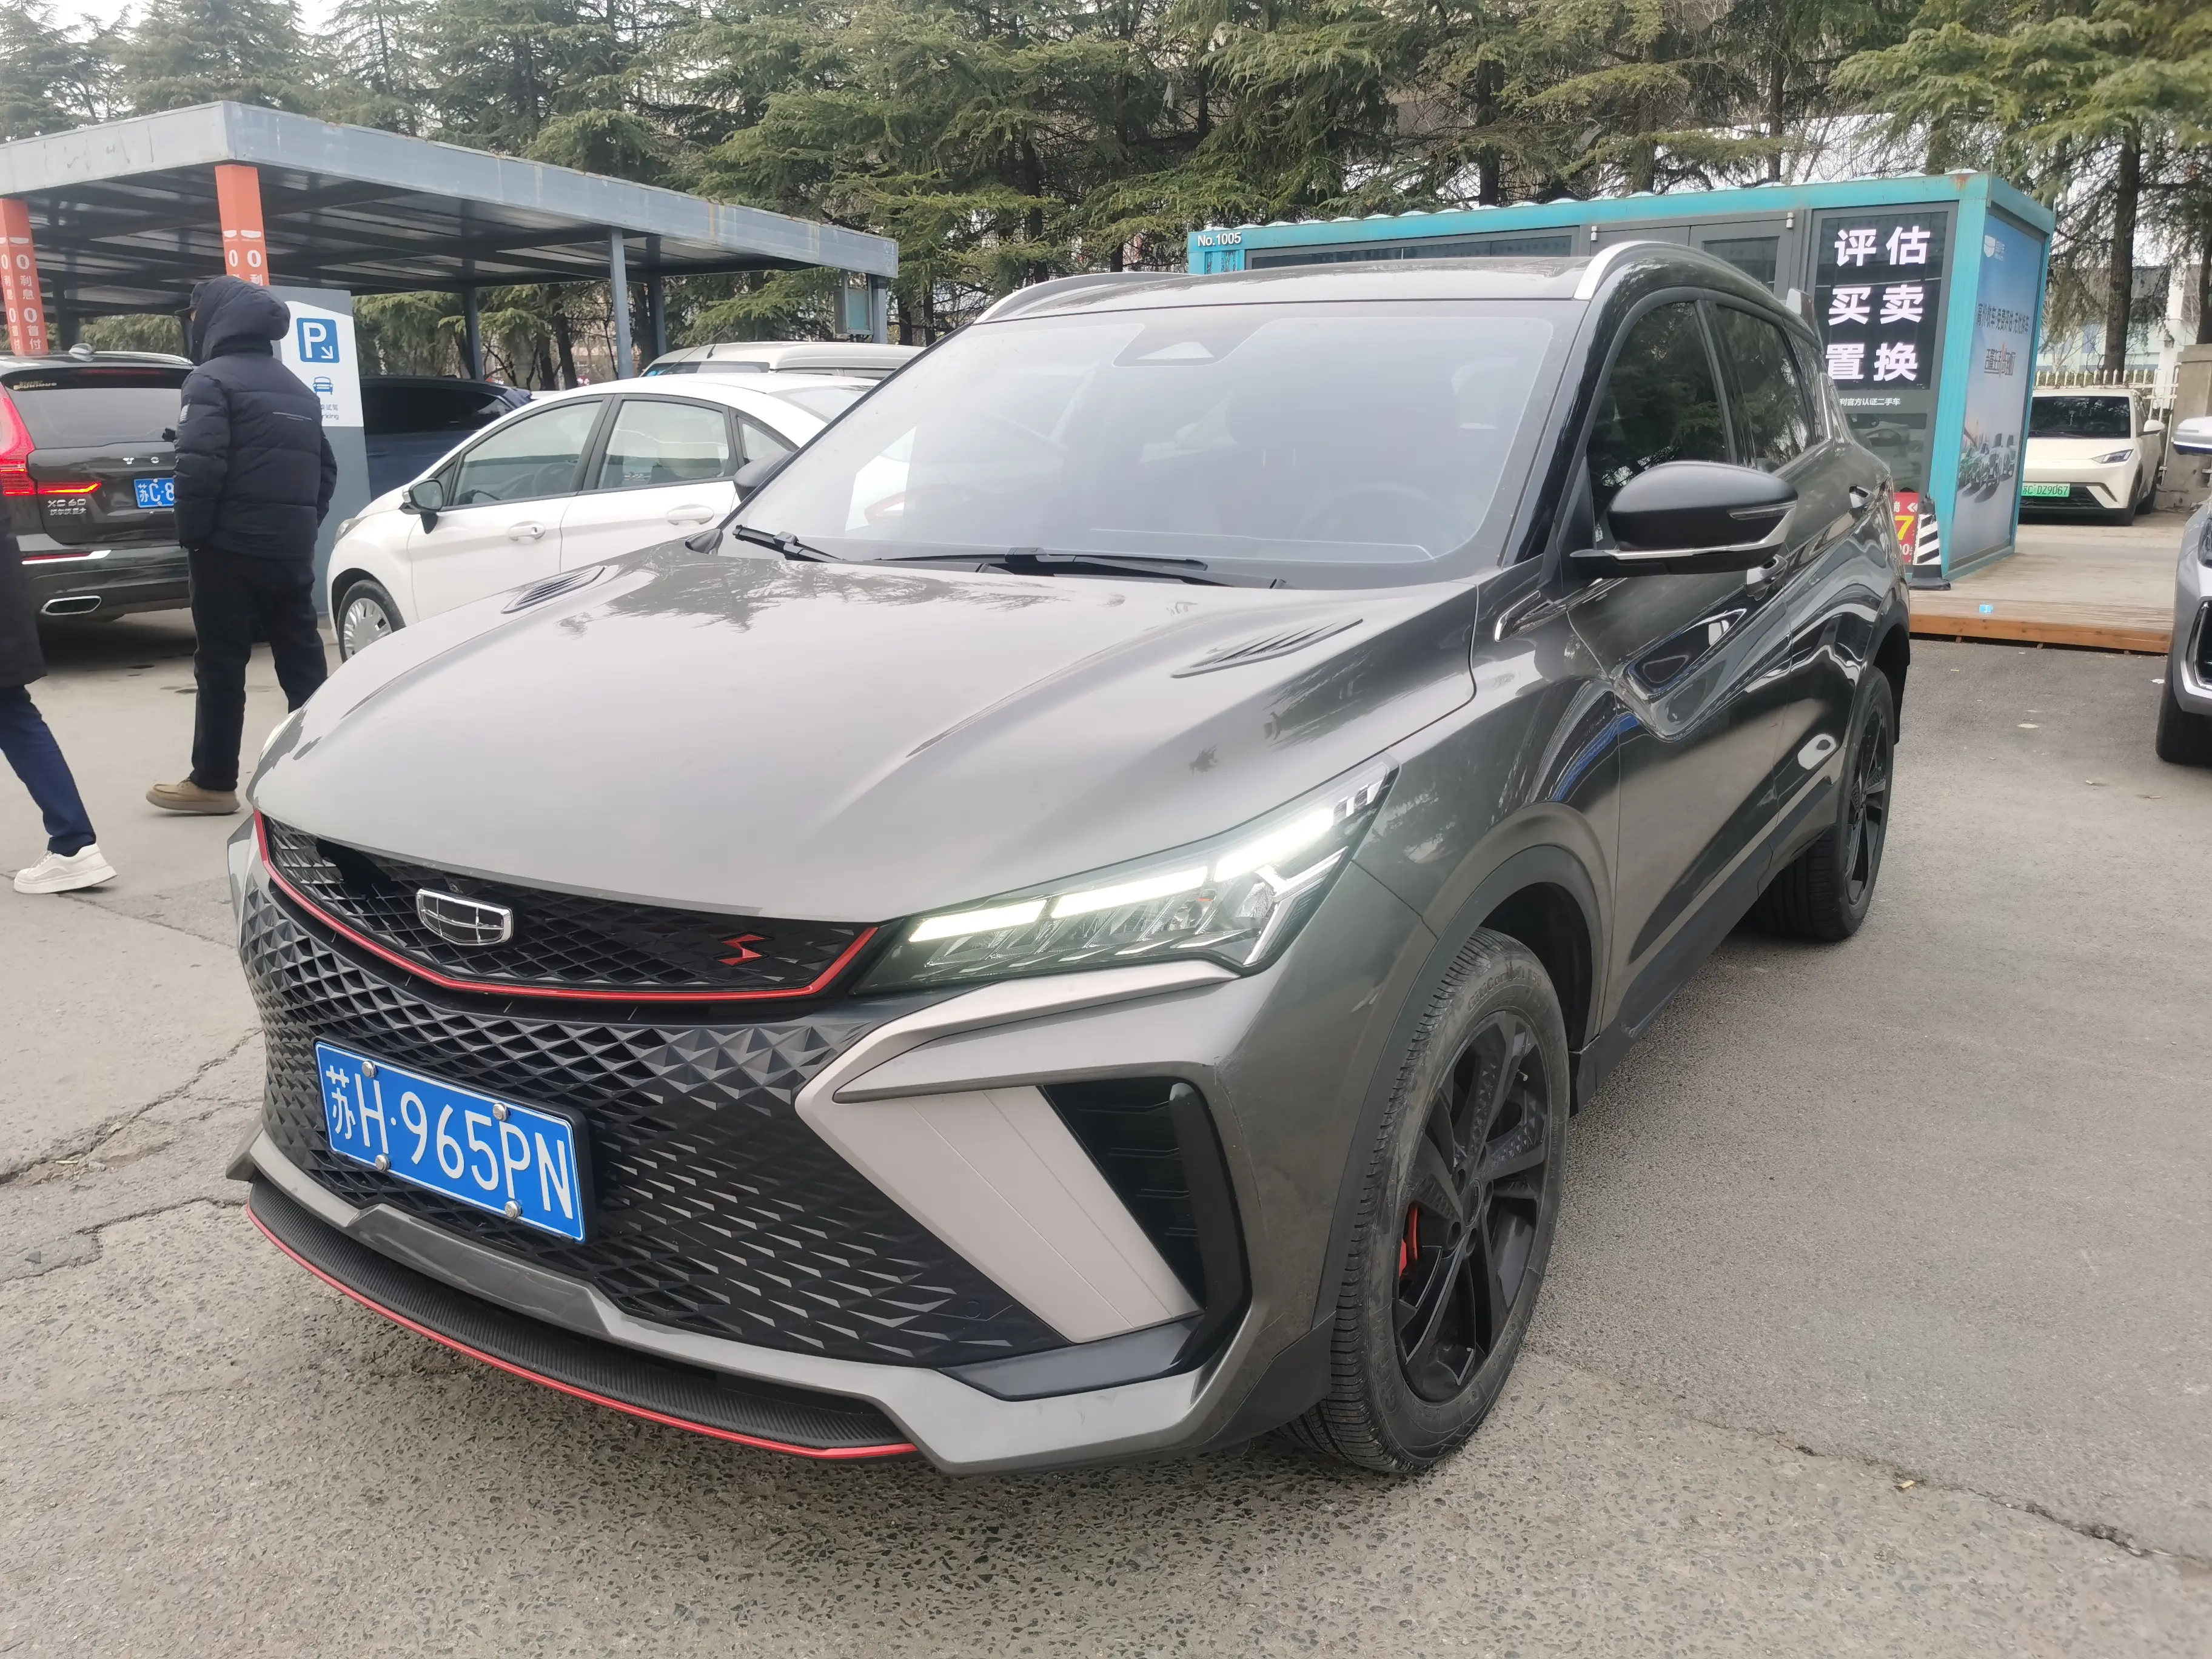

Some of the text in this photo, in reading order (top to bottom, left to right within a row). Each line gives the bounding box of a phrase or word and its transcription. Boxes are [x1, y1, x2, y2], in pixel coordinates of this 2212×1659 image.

[1198, 232, 1242, 247] No.1005
[1834, 226, 1931, 267] 评估
[1828, 284, 1924, 326] 买卖
[303, 322, 327, 358] P
[1826, 342, 1918, 381] 置换
